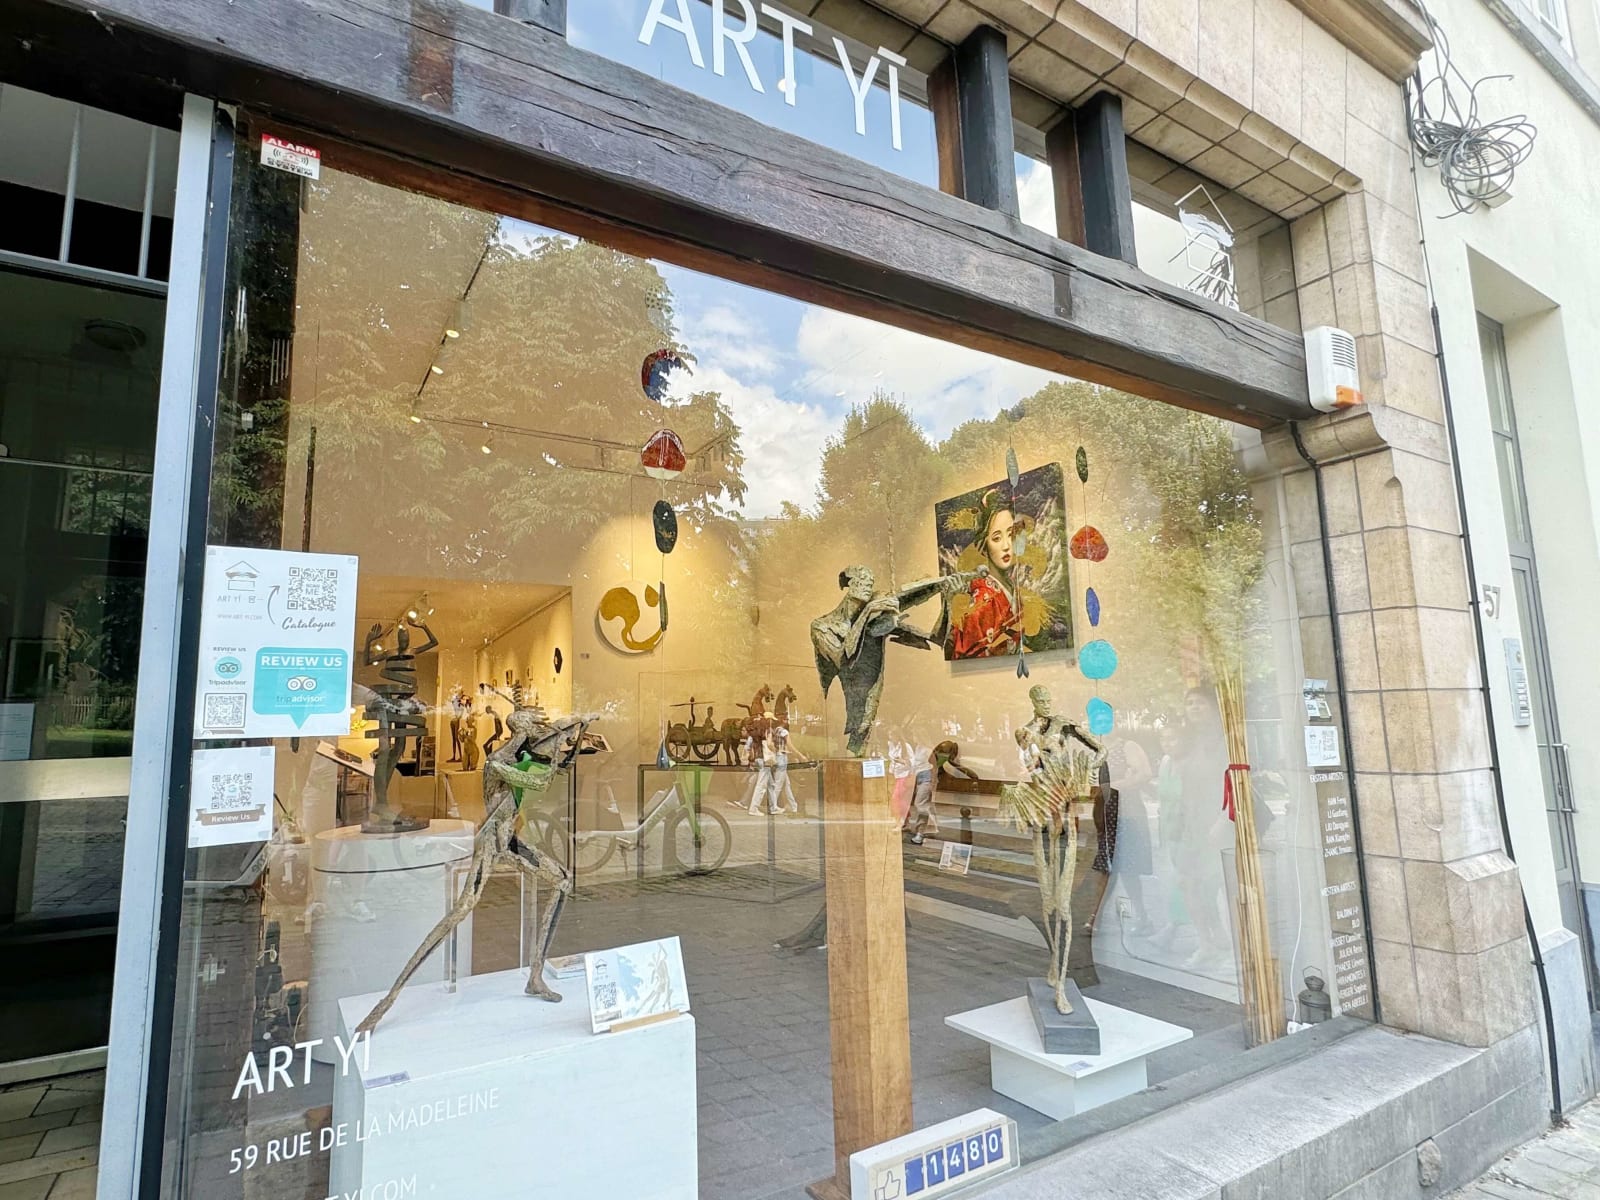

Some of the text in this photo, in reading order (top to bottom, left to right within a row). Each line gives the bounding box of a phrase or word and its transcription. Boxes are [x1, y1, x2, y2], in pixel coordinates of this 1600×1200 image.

[637, 0, 813, 107] ART
[267, 138, 317, 157] ALARM
[305, 587, 320, 595] ME
[1482, 584, 1501, 620] 57
[281, 616, 337, 632] Catalogue
[260, 655, 343, 667] REVIEW US
[275, 694, 326, 704] tripadvisor
[211, 814, 238, 823] Review
[231, 1030, 371, 1100] ART YI
[228, 1088, 500, 1174] 59 RUE DE LA MADELEINE
[930, 1133, 999, 1176] 1480
